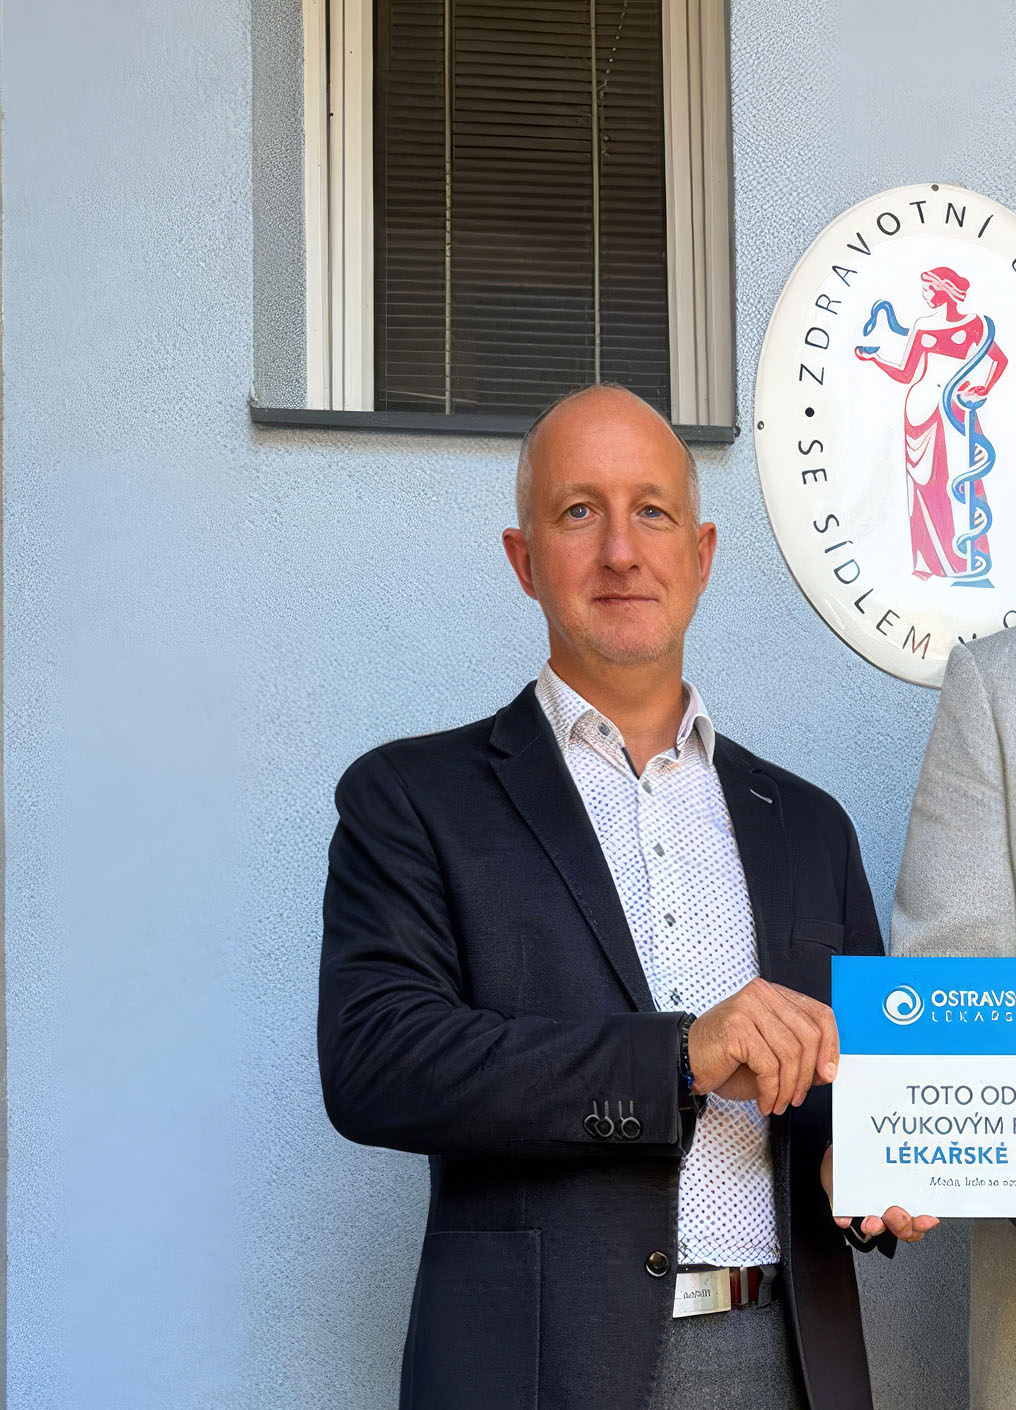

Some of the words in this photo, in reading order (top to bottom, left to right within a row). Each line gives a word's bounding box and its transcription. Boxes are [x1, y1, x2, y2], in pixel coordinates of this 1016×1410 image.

[799, 200, 994, 387] ZDRAVOTNÍ
[798, 438, 828, 486] SE
[813, 513, 932, 660] SÍDLEM
[906, 1085, 973, 1105] TOTO
[870, 1111, 1004, 1136] VÝUKOVÝM
[886, 1141, 1008, 1165] LÉKAŘSKÉ
